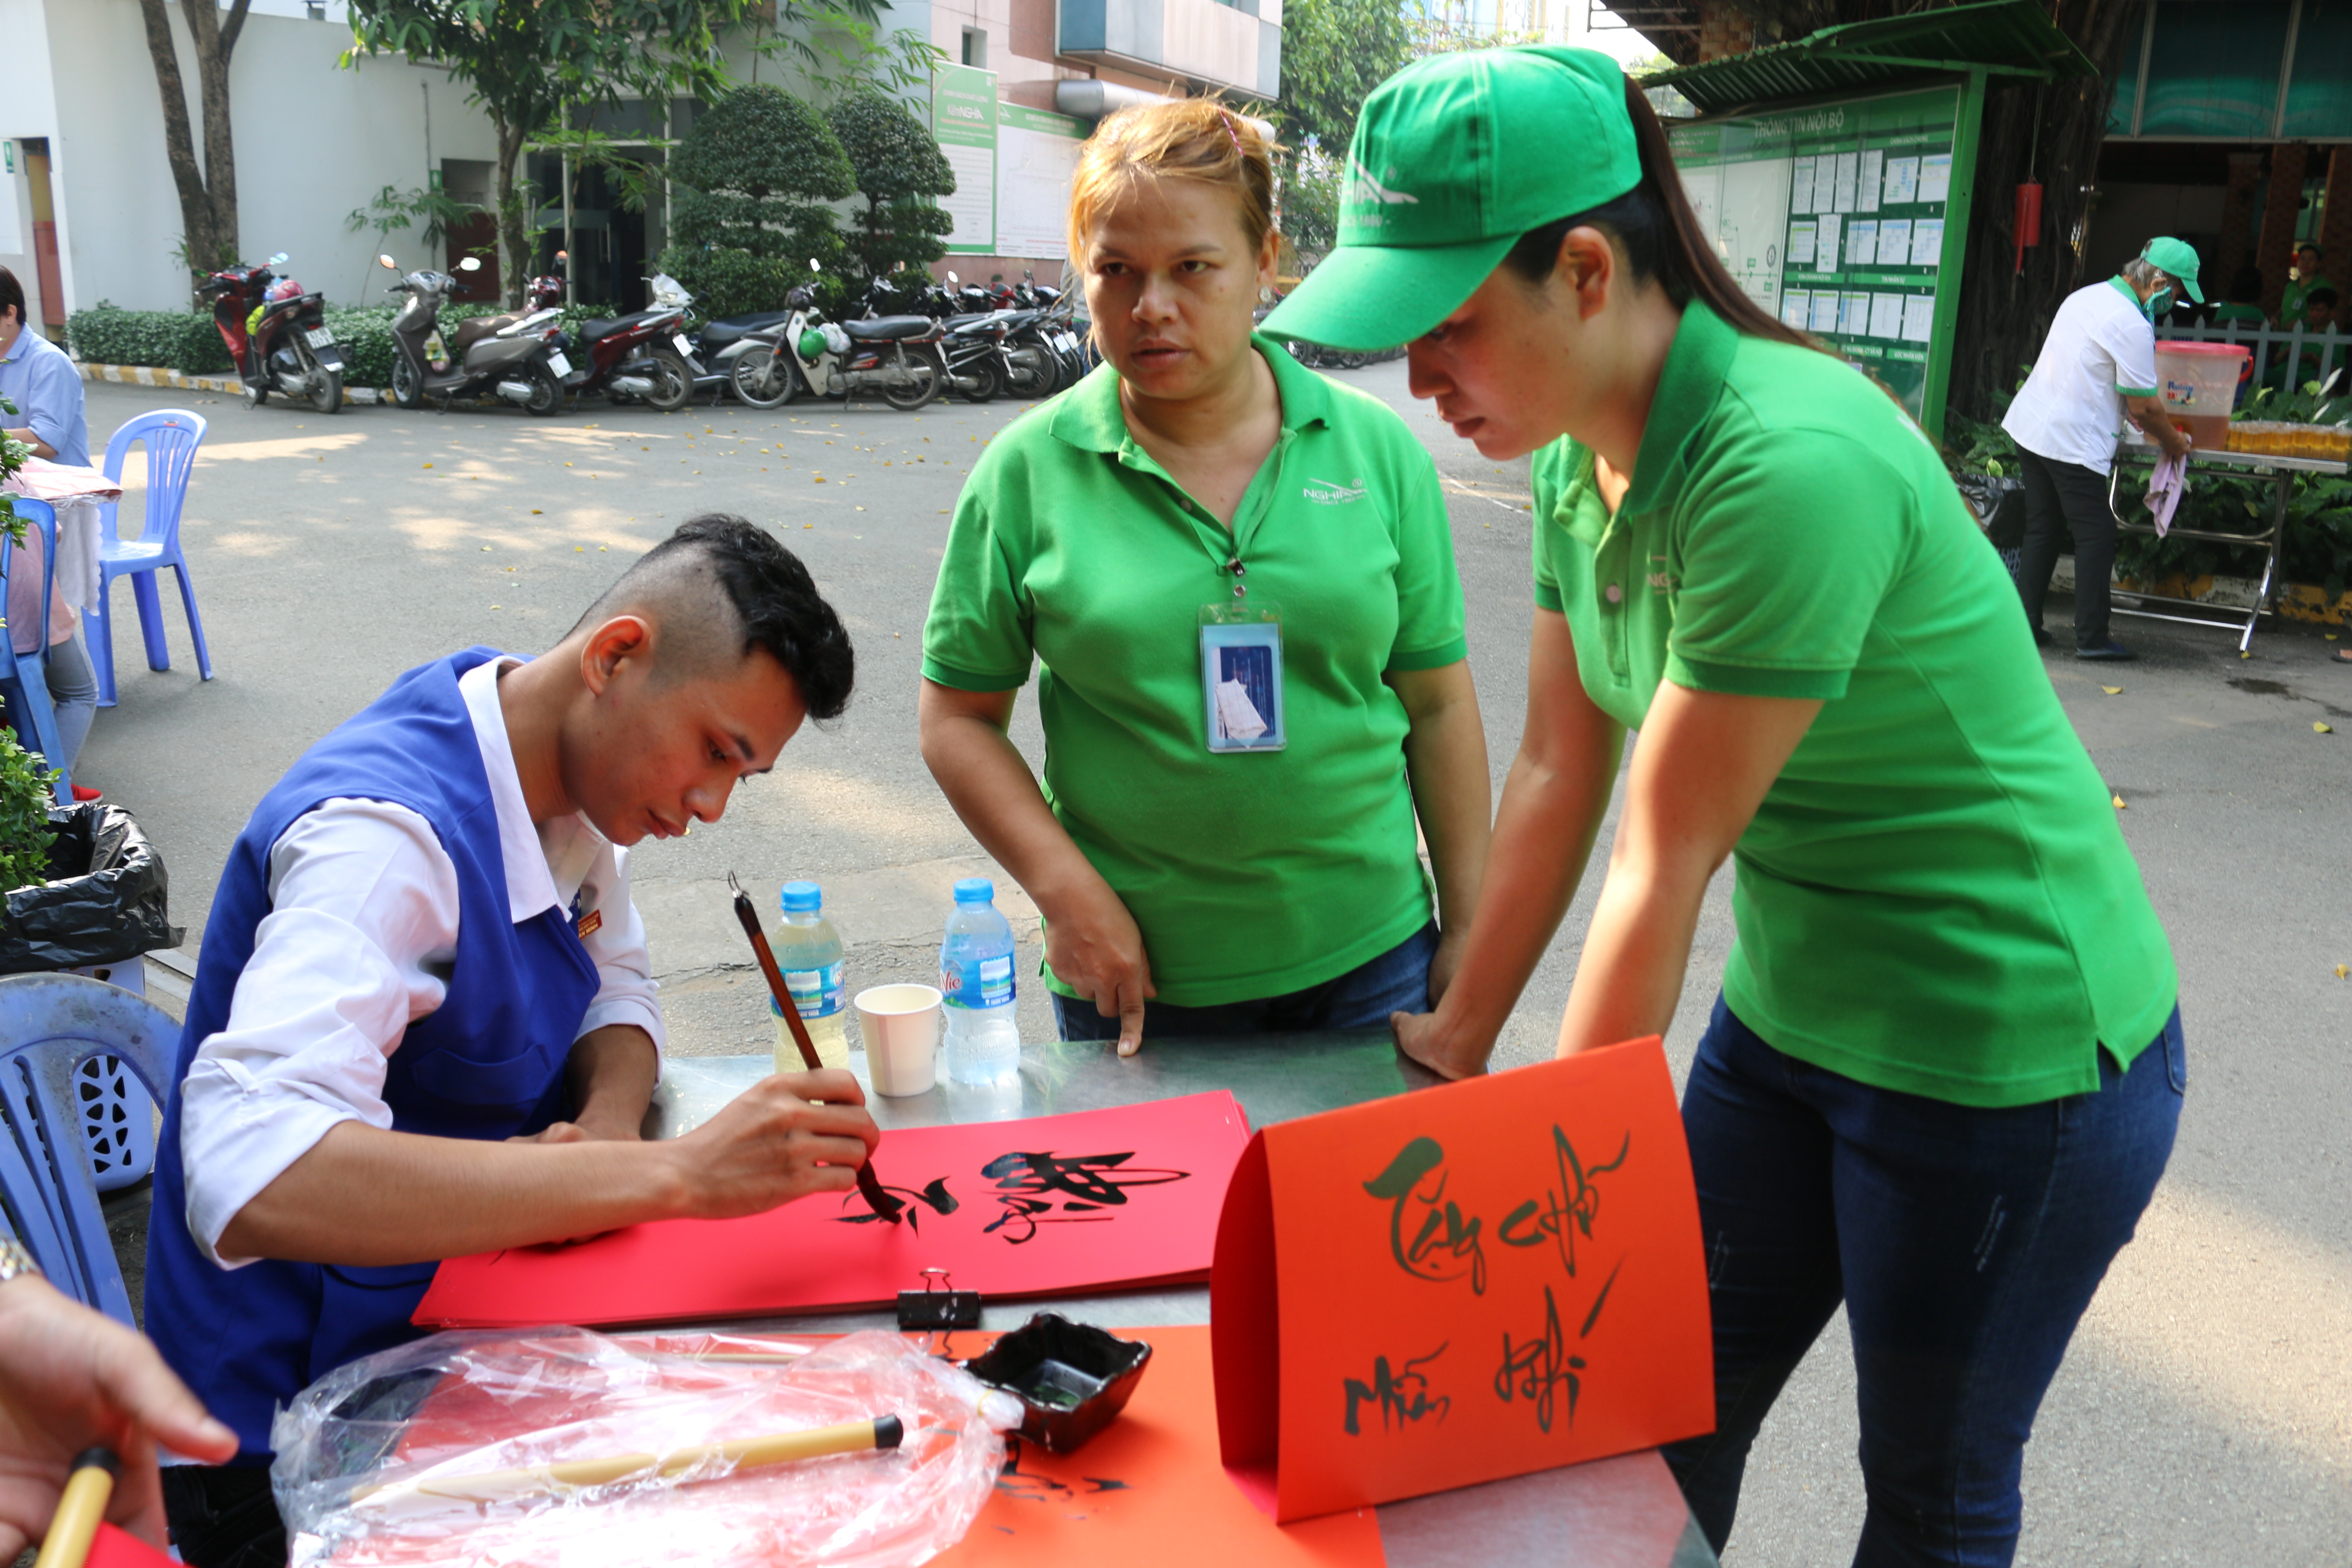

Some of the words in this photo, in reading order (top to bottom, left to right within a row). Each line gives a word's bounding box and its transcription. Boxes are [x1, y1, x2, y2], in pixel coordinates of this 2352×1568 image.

[1755, 117, 1787, 138] THÔNG
[1807, 110, 1827, 135] NỘI
[1828, 107, 1844, 133] BỘ
[586, 923, 598, 934] MINH
[1344, 1340, 1450, 1436] Miễn
